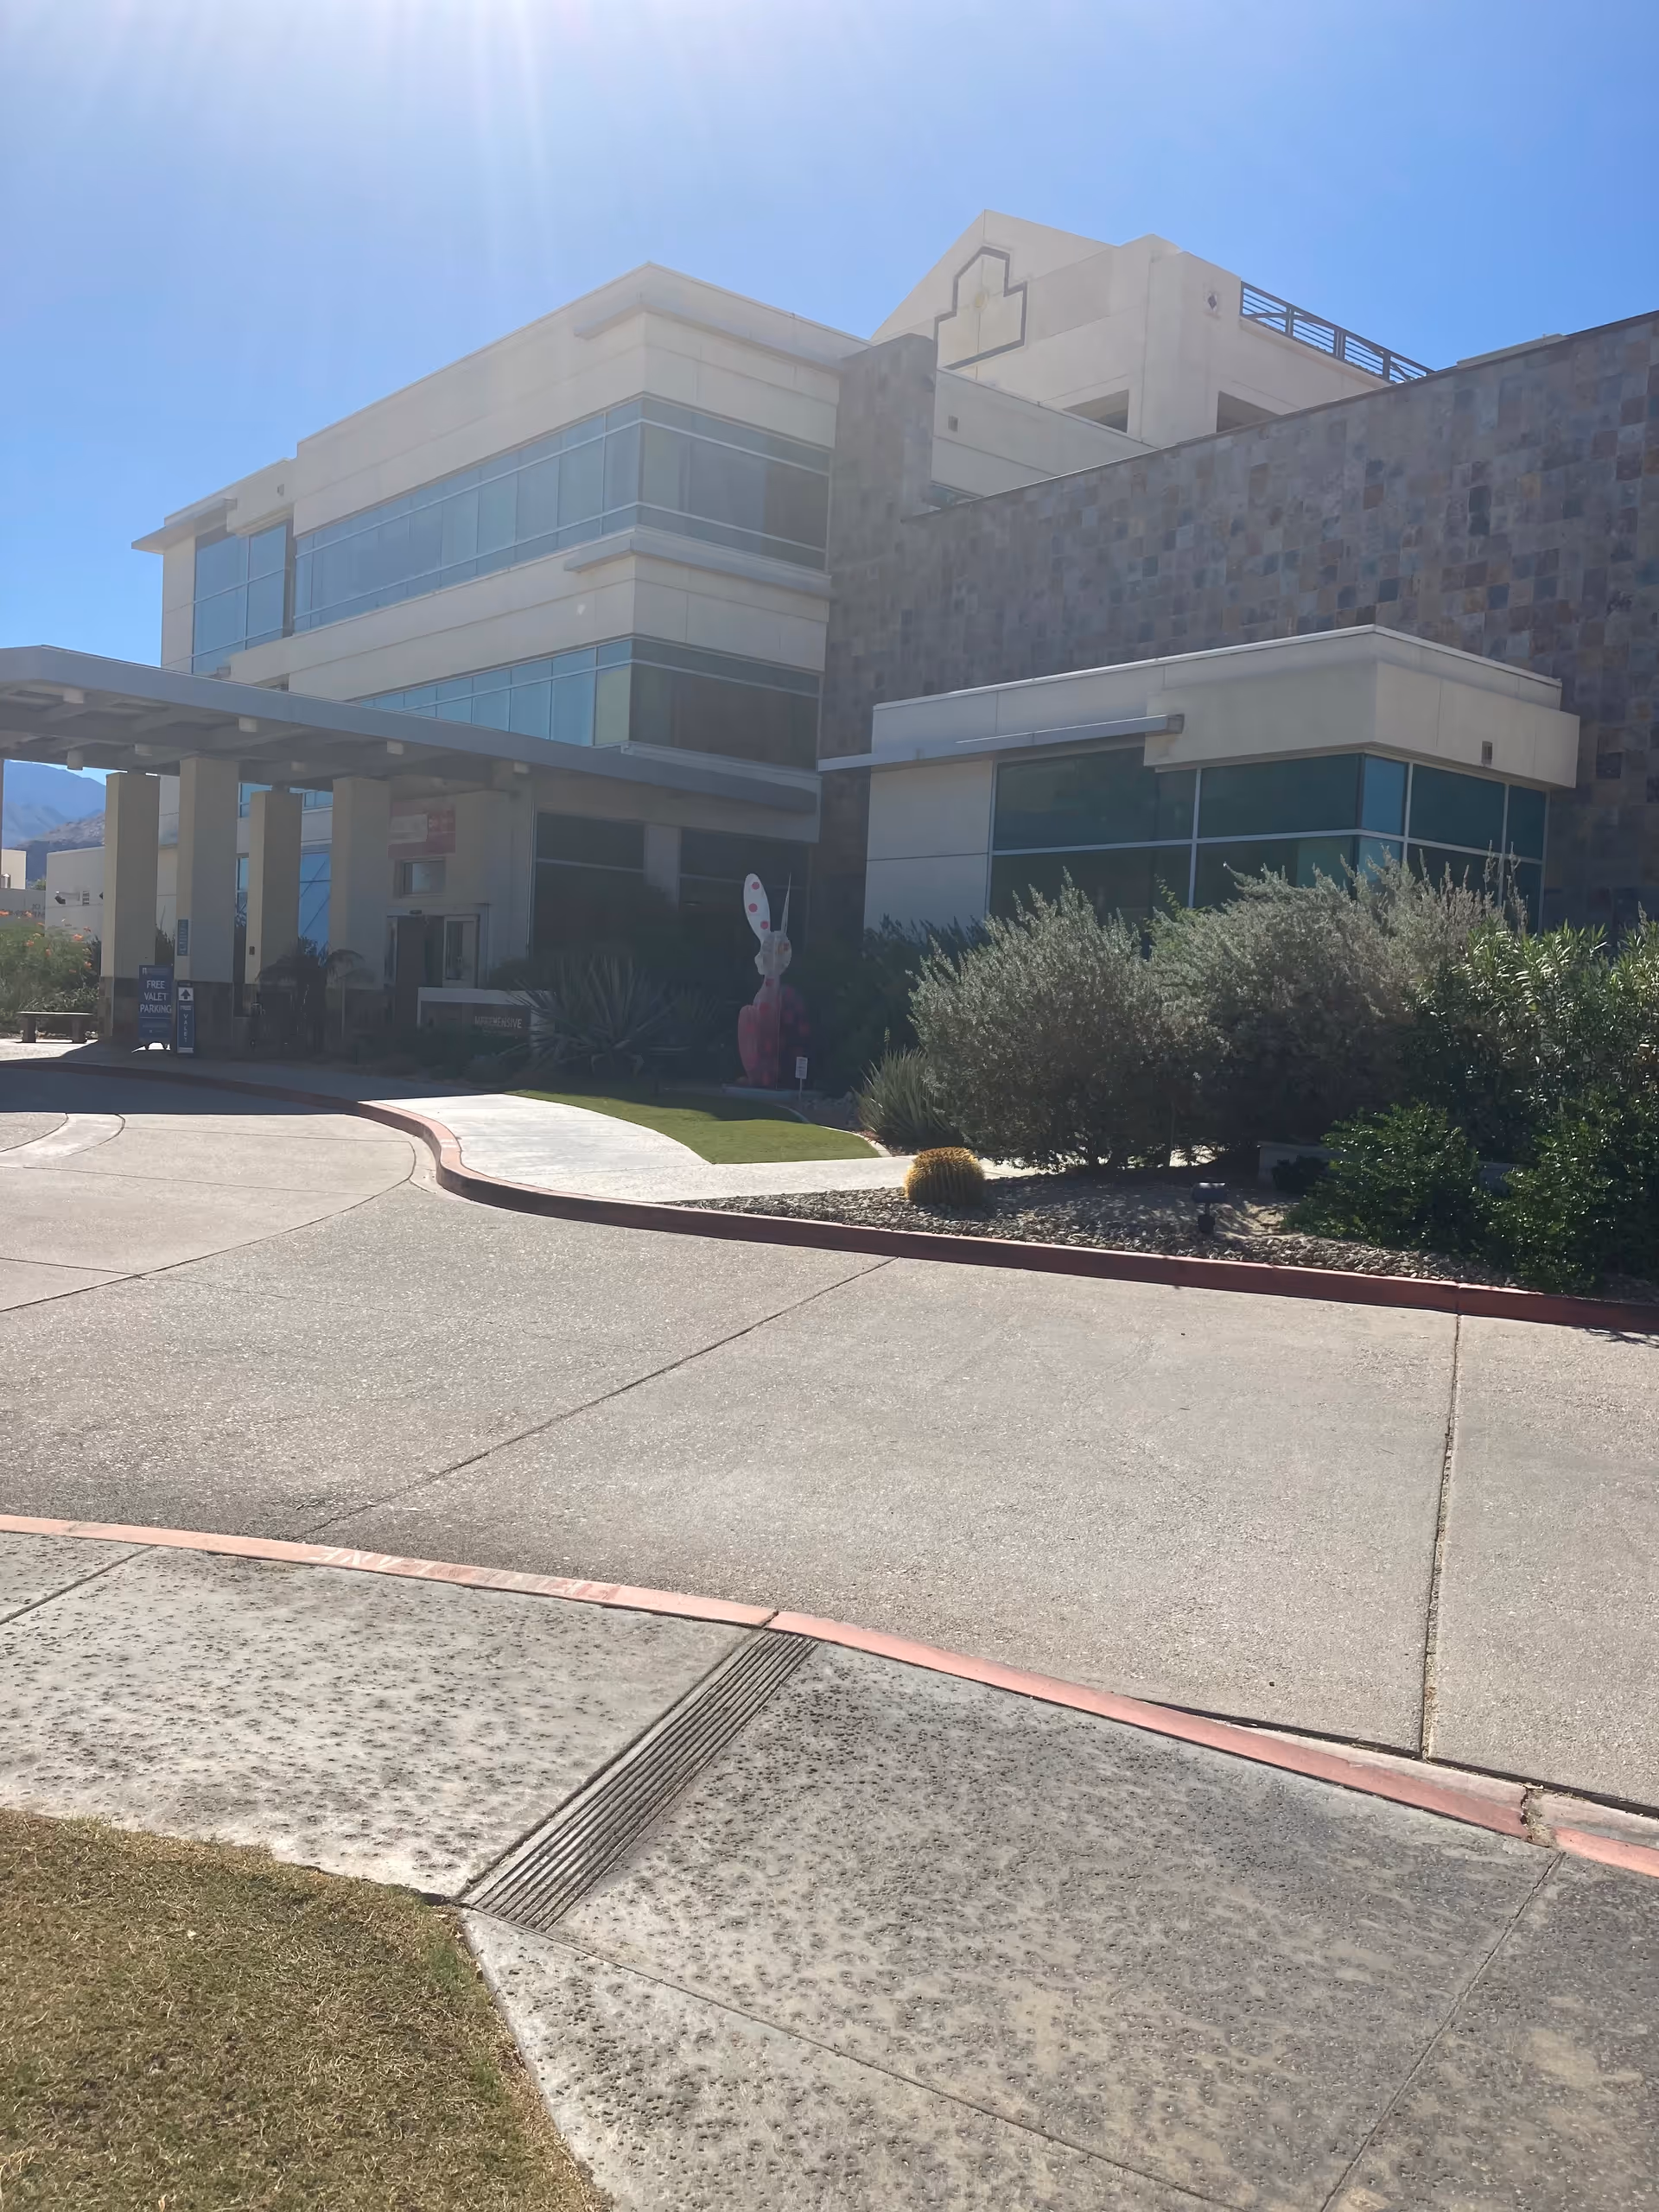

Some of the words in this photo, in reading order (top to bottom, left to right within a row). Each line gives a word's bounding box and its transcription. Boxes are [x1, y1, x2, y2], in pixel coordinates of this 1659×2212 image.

[146, 980, 166, 989] FREE
[143, 992, 168, 1001] VALET
[139, 1004, 172, 1014] PARKING
